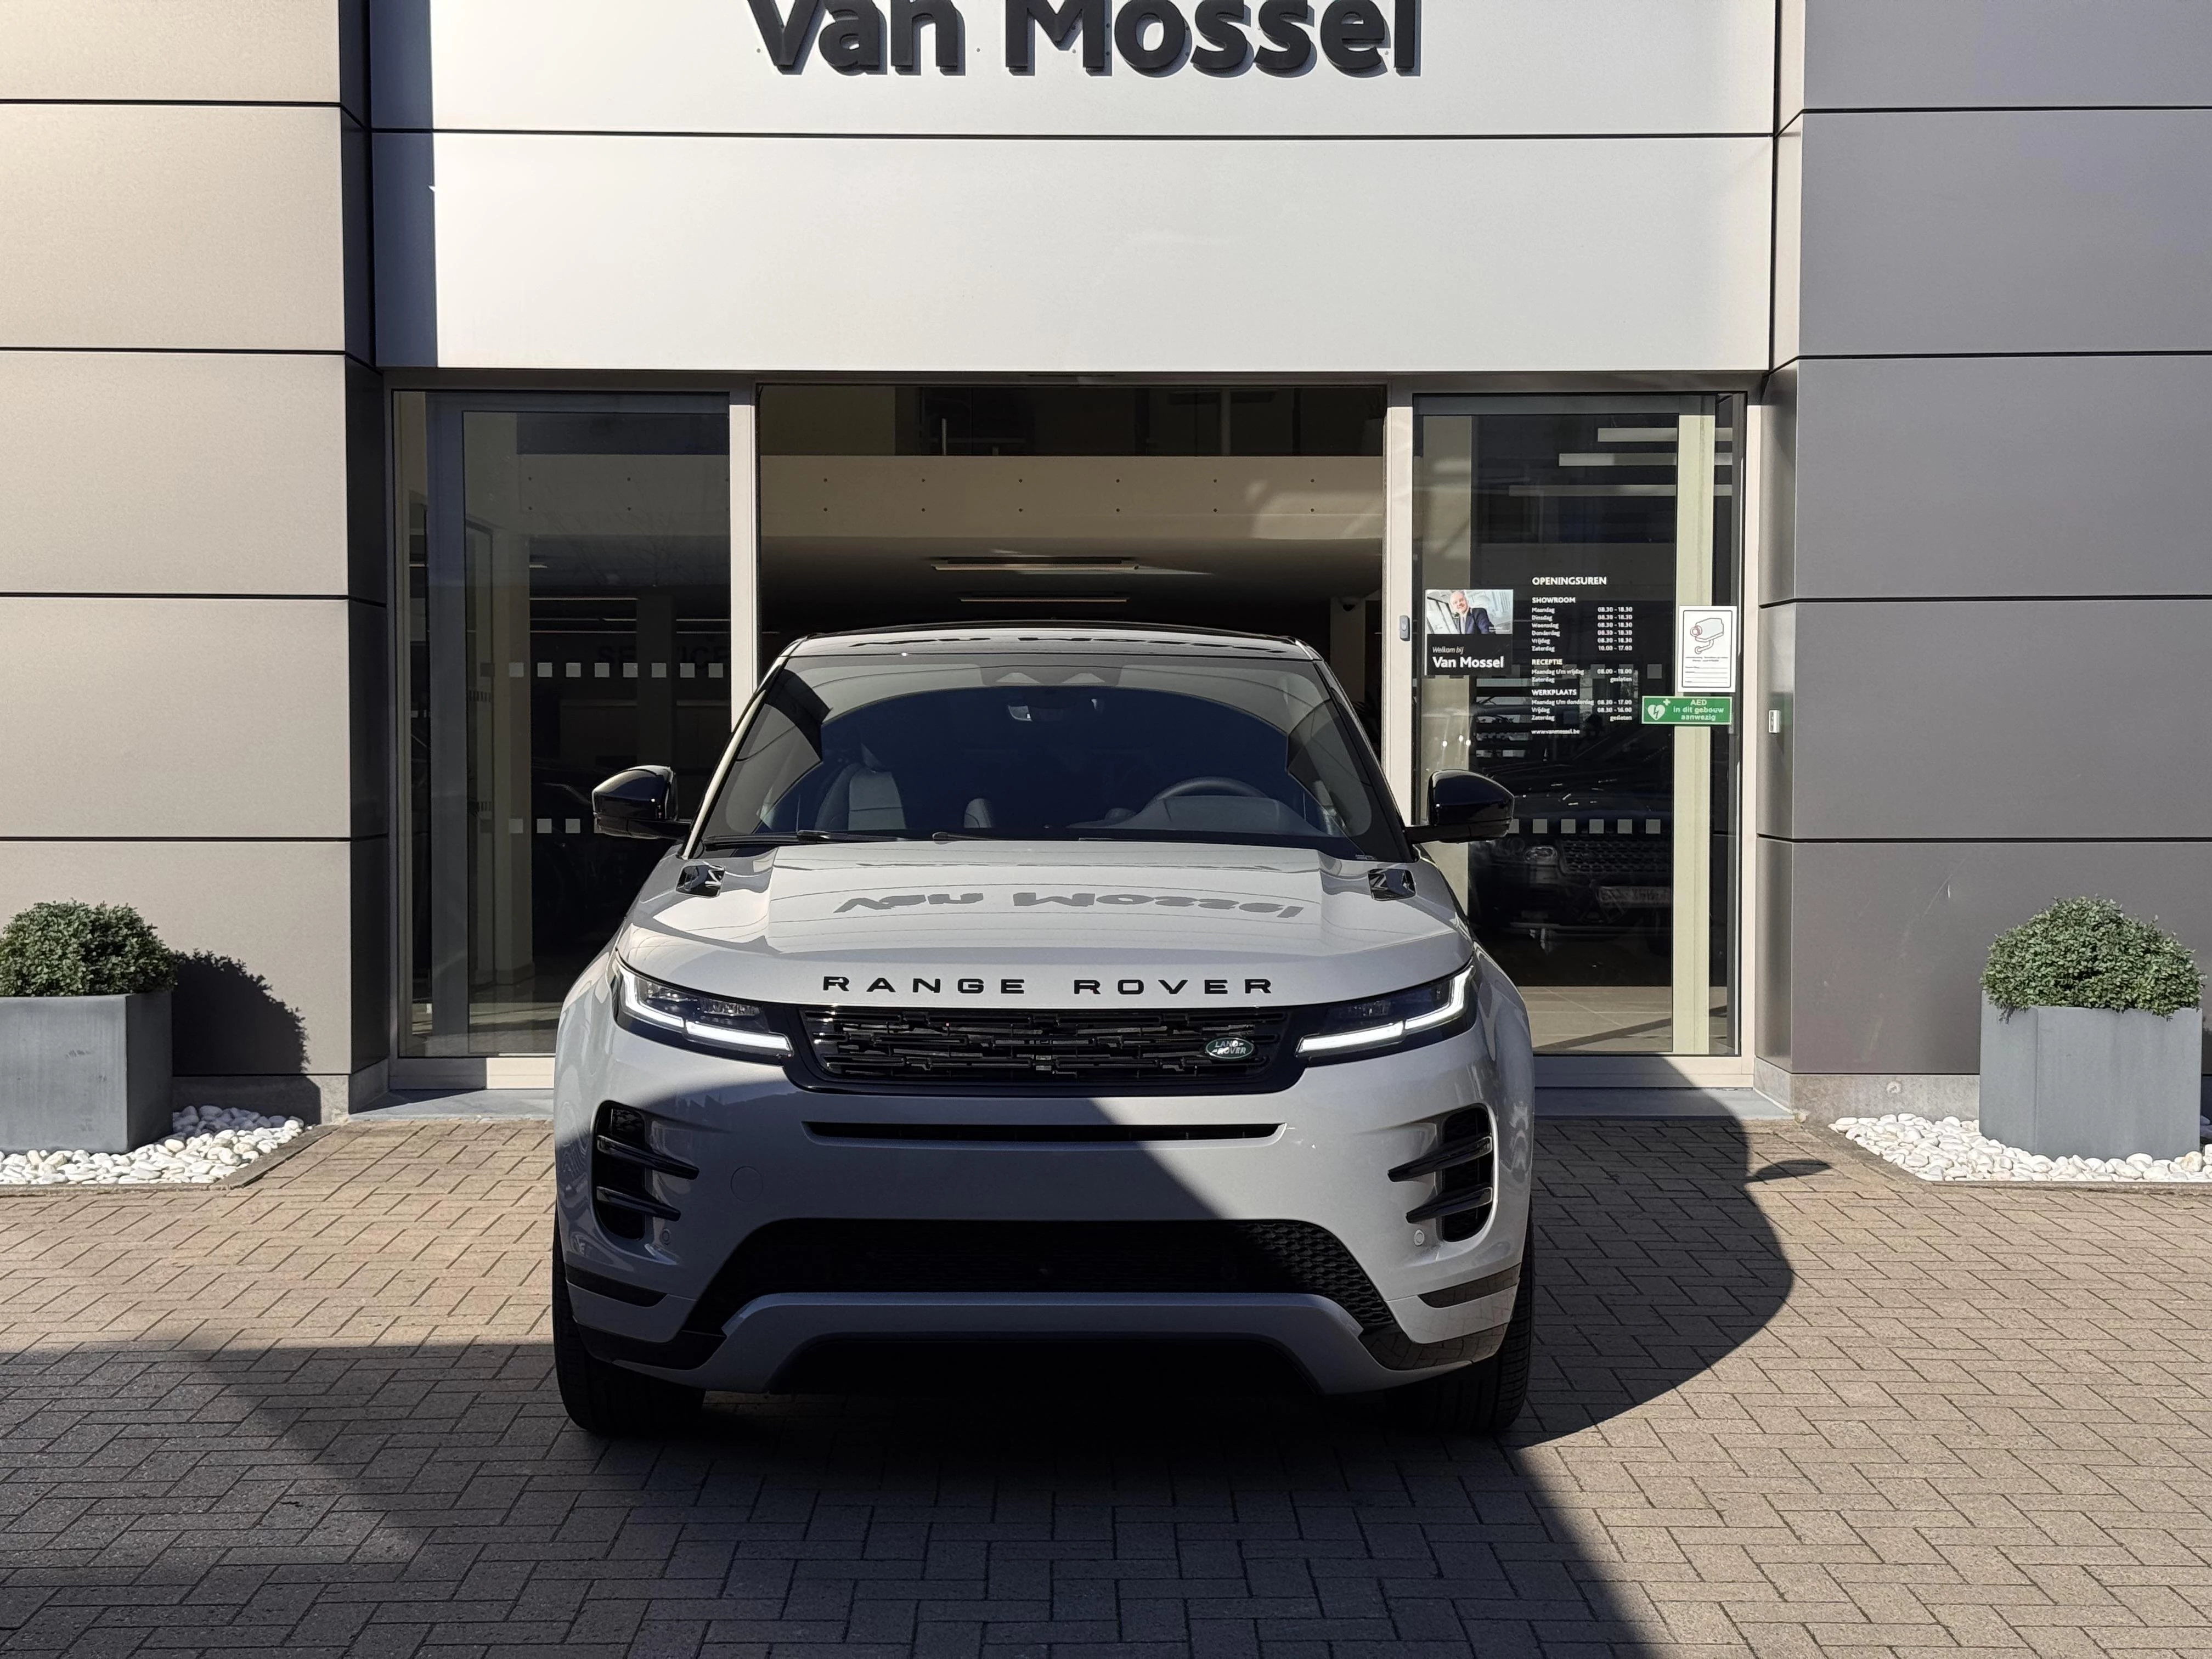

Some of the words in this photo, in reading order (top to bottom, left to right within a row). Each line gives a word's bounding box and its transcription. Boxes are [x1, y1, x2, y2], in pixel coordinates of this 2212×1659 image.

[748, 0, 964, 75] Van
[1006, 0, 1421, 75] Mossel
[1532, 577, 1607, 585] OPENINGSUREN
[1432, 656, 1457, 668] Van
[1460, 656, 1504, 668] Mossel
[823, 976, 1025, 995] RANGE
[1073, 979, 1273, 995] ROVER
